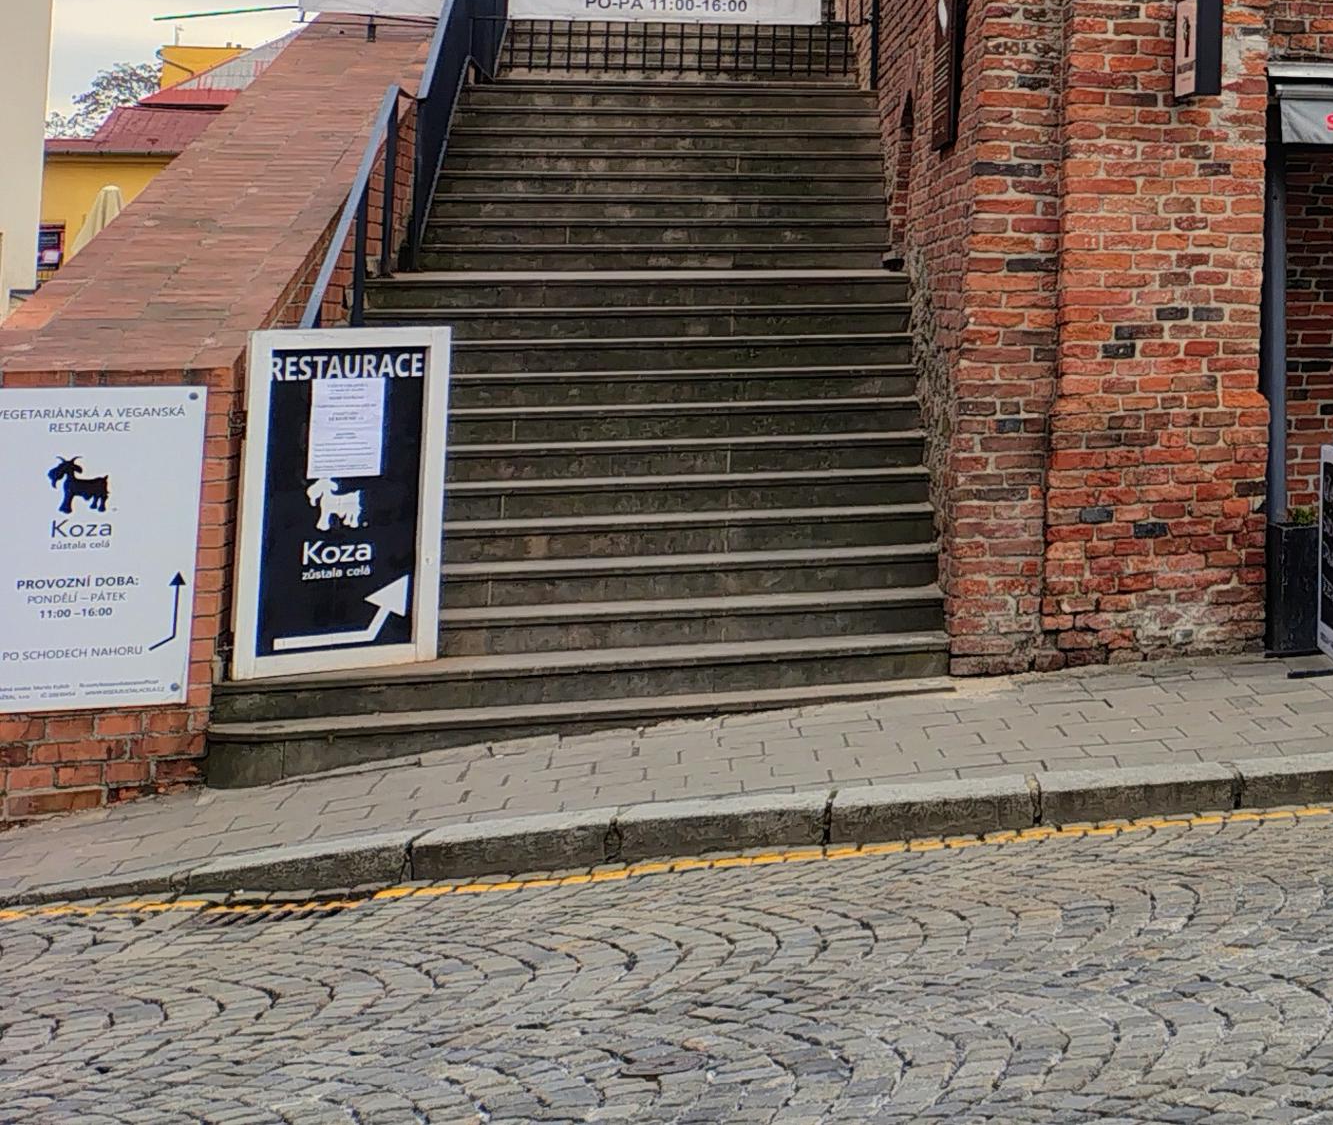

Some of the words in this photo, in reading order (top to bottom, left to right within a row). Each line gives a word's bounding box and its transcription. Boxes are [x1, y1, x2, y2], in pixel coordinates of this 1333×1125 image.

[272, 352, 424, 382] RESTAURACE
[103, 408, 113, 419] A
[117, 405, 186, 418] VEGANSKÁ
[49, 421, 131, 433] RESTAURACE
[51, 519, 112, 538] Koza
[50, 540, 87, 551] zůstala
[89, 539, 111, 549] celá
[302, 540, 372, 566] Koza
[302, 566, 343, 581] zůstala
[346, 564, 371, 577] celá
[16, 575, 91, 591] PROVOZNÍ
[95, 576, 140, 588] DOBA:
[27, 591, 78, 605] PONDĚLÍ
[39, 608, 72, 619] 11:00
[2, 651, 19, 661] PO
[22, 649, 87, 661] SCHODECH
[91, 646, 143, 658] NAHORU
